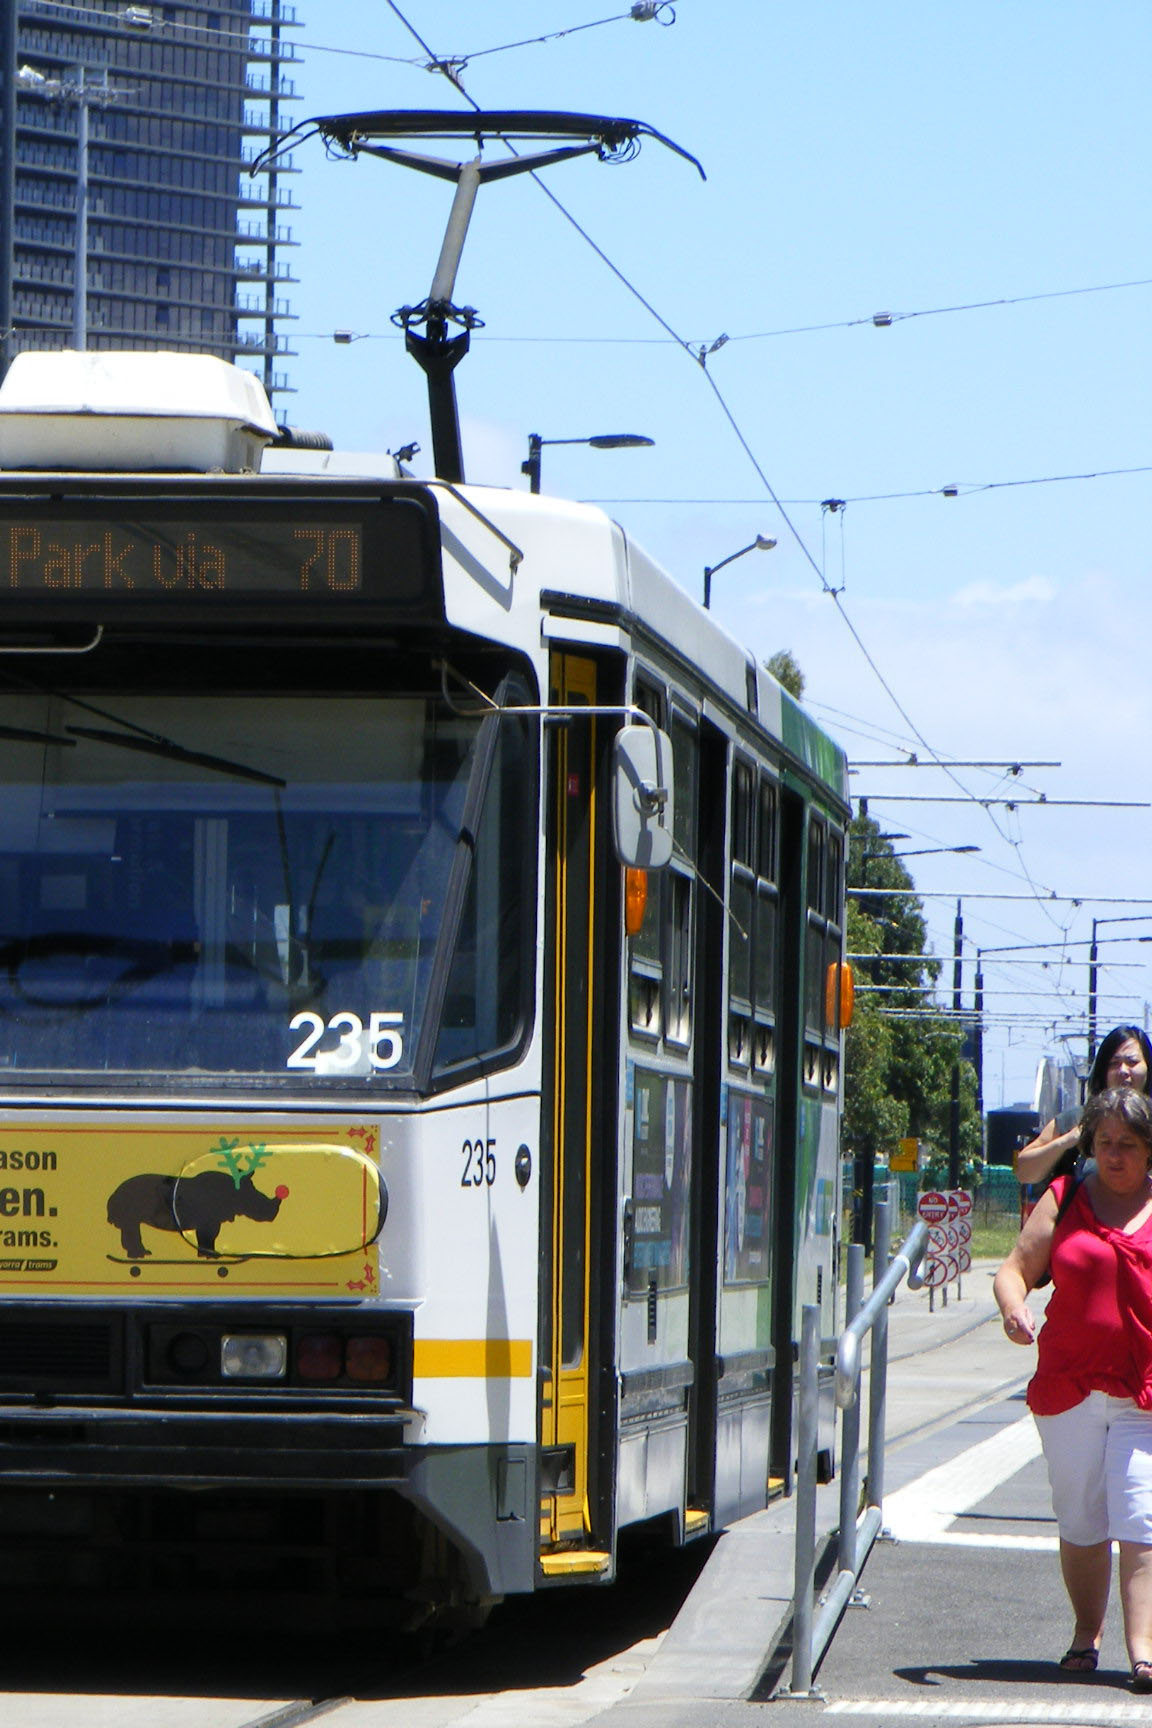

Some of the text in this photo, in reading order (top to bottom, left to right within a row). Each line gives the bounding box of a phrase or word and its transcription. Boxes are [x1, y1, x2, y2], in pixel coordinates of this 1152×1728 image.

[10, 526, 136, 589] Park
[153, 531, 227, 590] via
[294, 528, 360, 591] 70
[286, 1011, 405, 1070] 235
[461, 1138, 496, 1187] 235
[28, 1261, 53, 1269] trams
